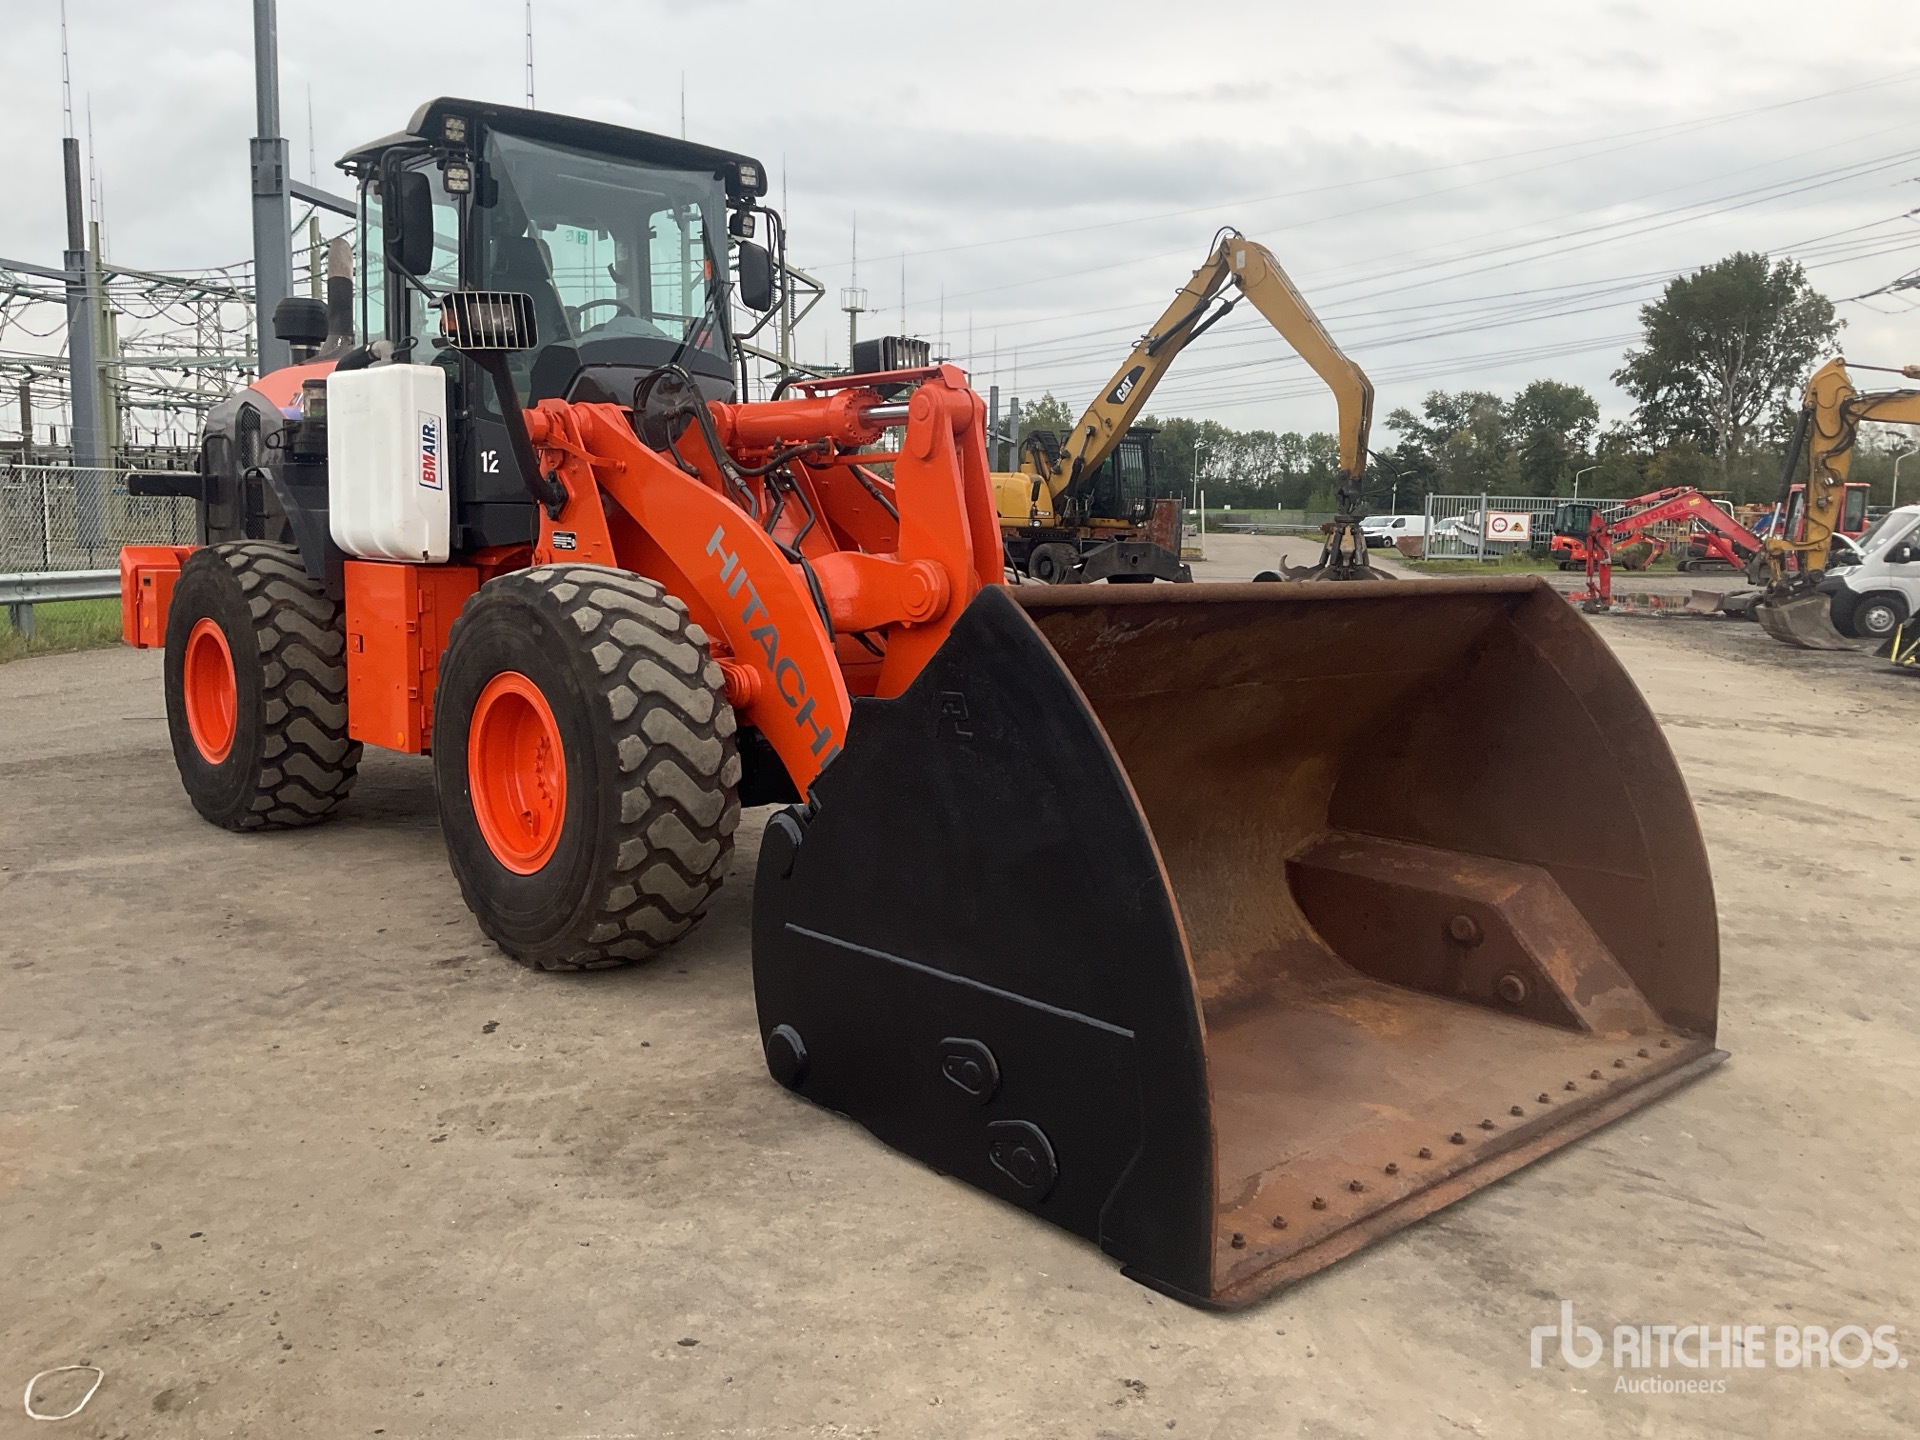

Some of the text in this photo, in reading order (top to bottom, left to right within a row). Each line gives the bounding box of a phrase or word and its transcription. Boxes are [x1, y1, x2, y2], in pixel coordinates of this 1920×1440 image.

[1116, 375, 1133, 402] CAT
[422, 424, 436, 483] BMAIR
[480, 450, 500, 473] 12
[1644, 502, 1686, 521] LOXAM
